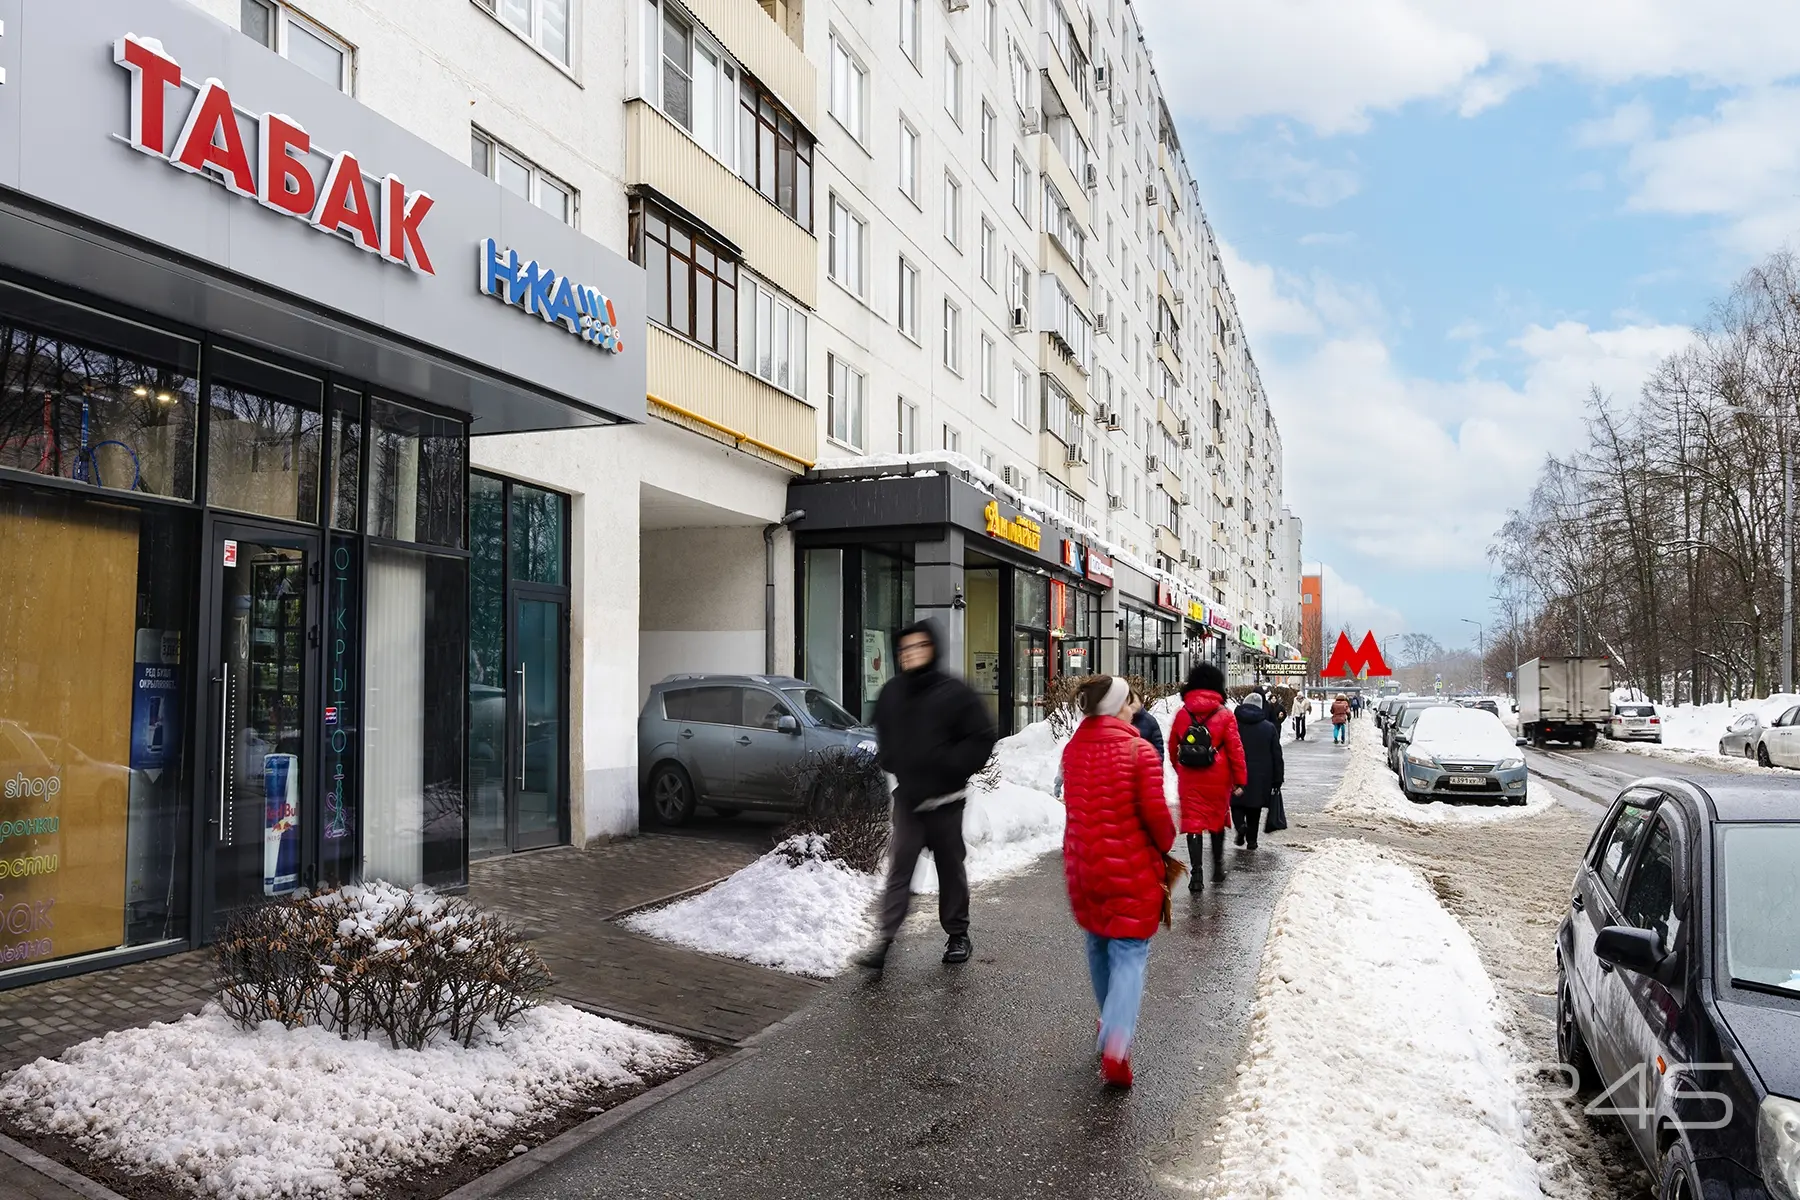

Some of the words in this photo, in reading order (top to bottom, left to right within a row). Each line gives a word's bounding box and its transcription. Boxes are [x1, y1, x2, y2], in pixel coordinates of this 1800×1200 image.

[114, 40, 435, 275] ТАБАК
[480, 237, 582, 334] НИКА
[331, 547, 350, 753] ОТКРЫТО
[4, 772, 61, 802] shop
[0, 893, 55, 935] ак
